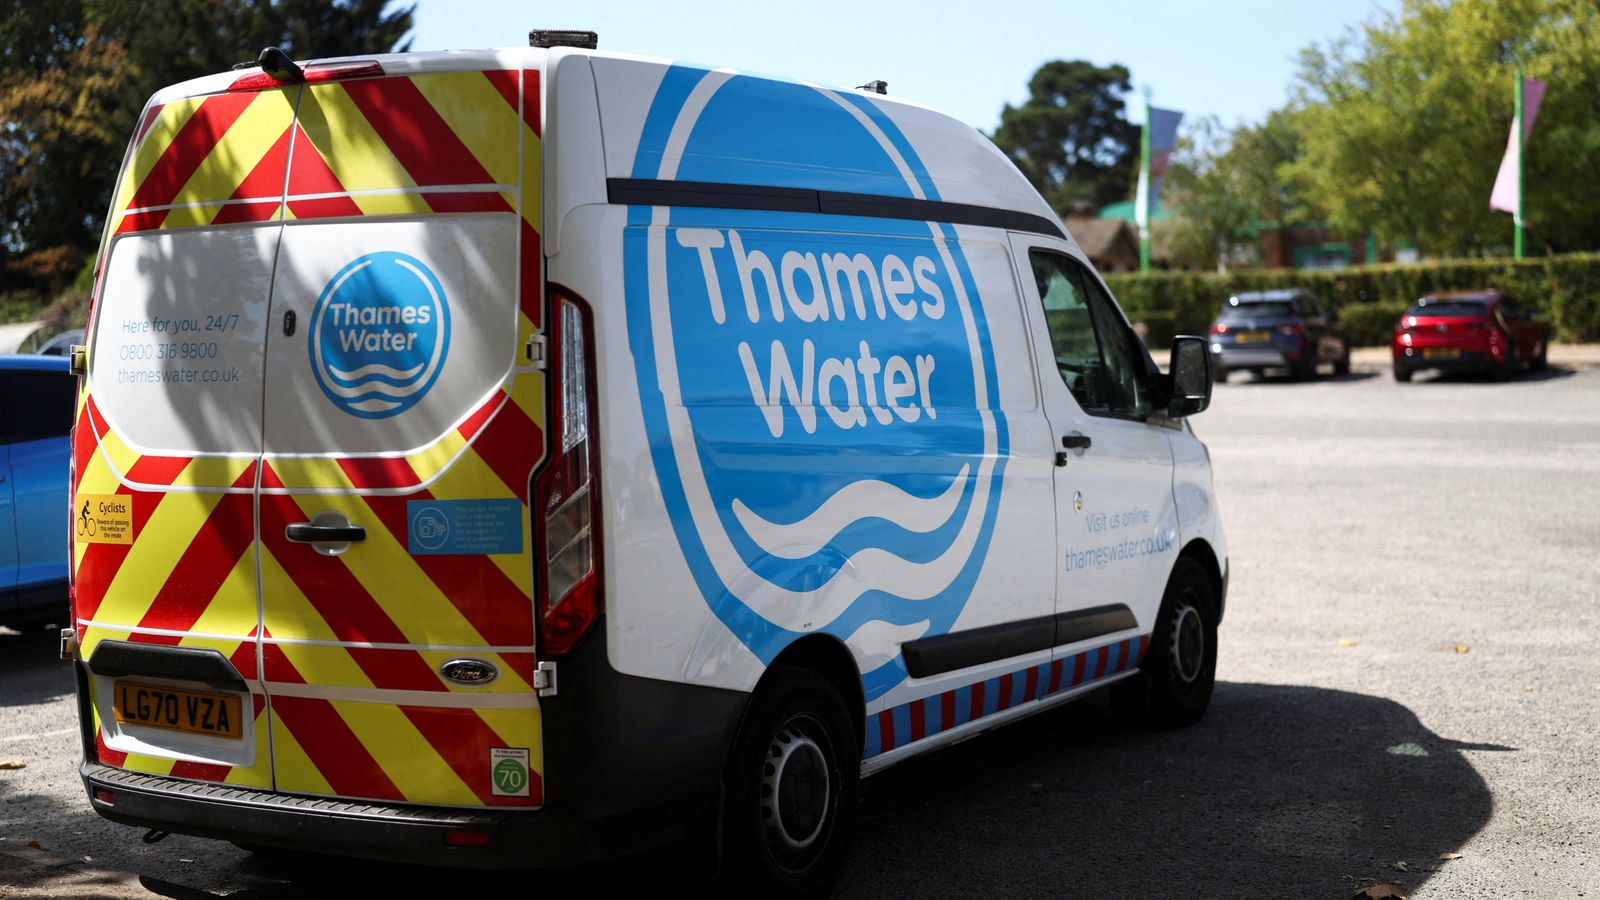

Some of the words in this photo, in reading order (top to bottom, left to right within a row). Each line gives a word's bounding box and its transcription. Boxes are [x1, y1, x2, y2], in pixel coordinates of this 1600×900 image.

[675, 228, 945, 324] Thames
[122, 319, 149, 334] Here
[152, 317, 170, 332] for
[173, 318, 201, 335] you,
[205, 313, 240, 332] 24/7
[329, 303, 431, 326] Thames
[120, 344, 153, 360] 0800
[156, 343, 177, 360] 316
[180, 342, 218, 359] 9800
[338, 328, 418, 352] Water
[118, 365, 240, 384] thameswater.co.uk
[738, 338, 937, 438] Water
[99, 501, 126, 515] Cyclists
[1086, 512, 1108, 533] Visit
[1110, 513, 1120, 530] us
[1122, 507, 1149, 527] online
[1065, 530, 1172, 572] thameswater.co.uk
[450, 665, 481, 680] Ford
[122, 687, 179, 725] LG70
[185, 695, 230, 733] VZA
[499, 770, 521, 788] 70
